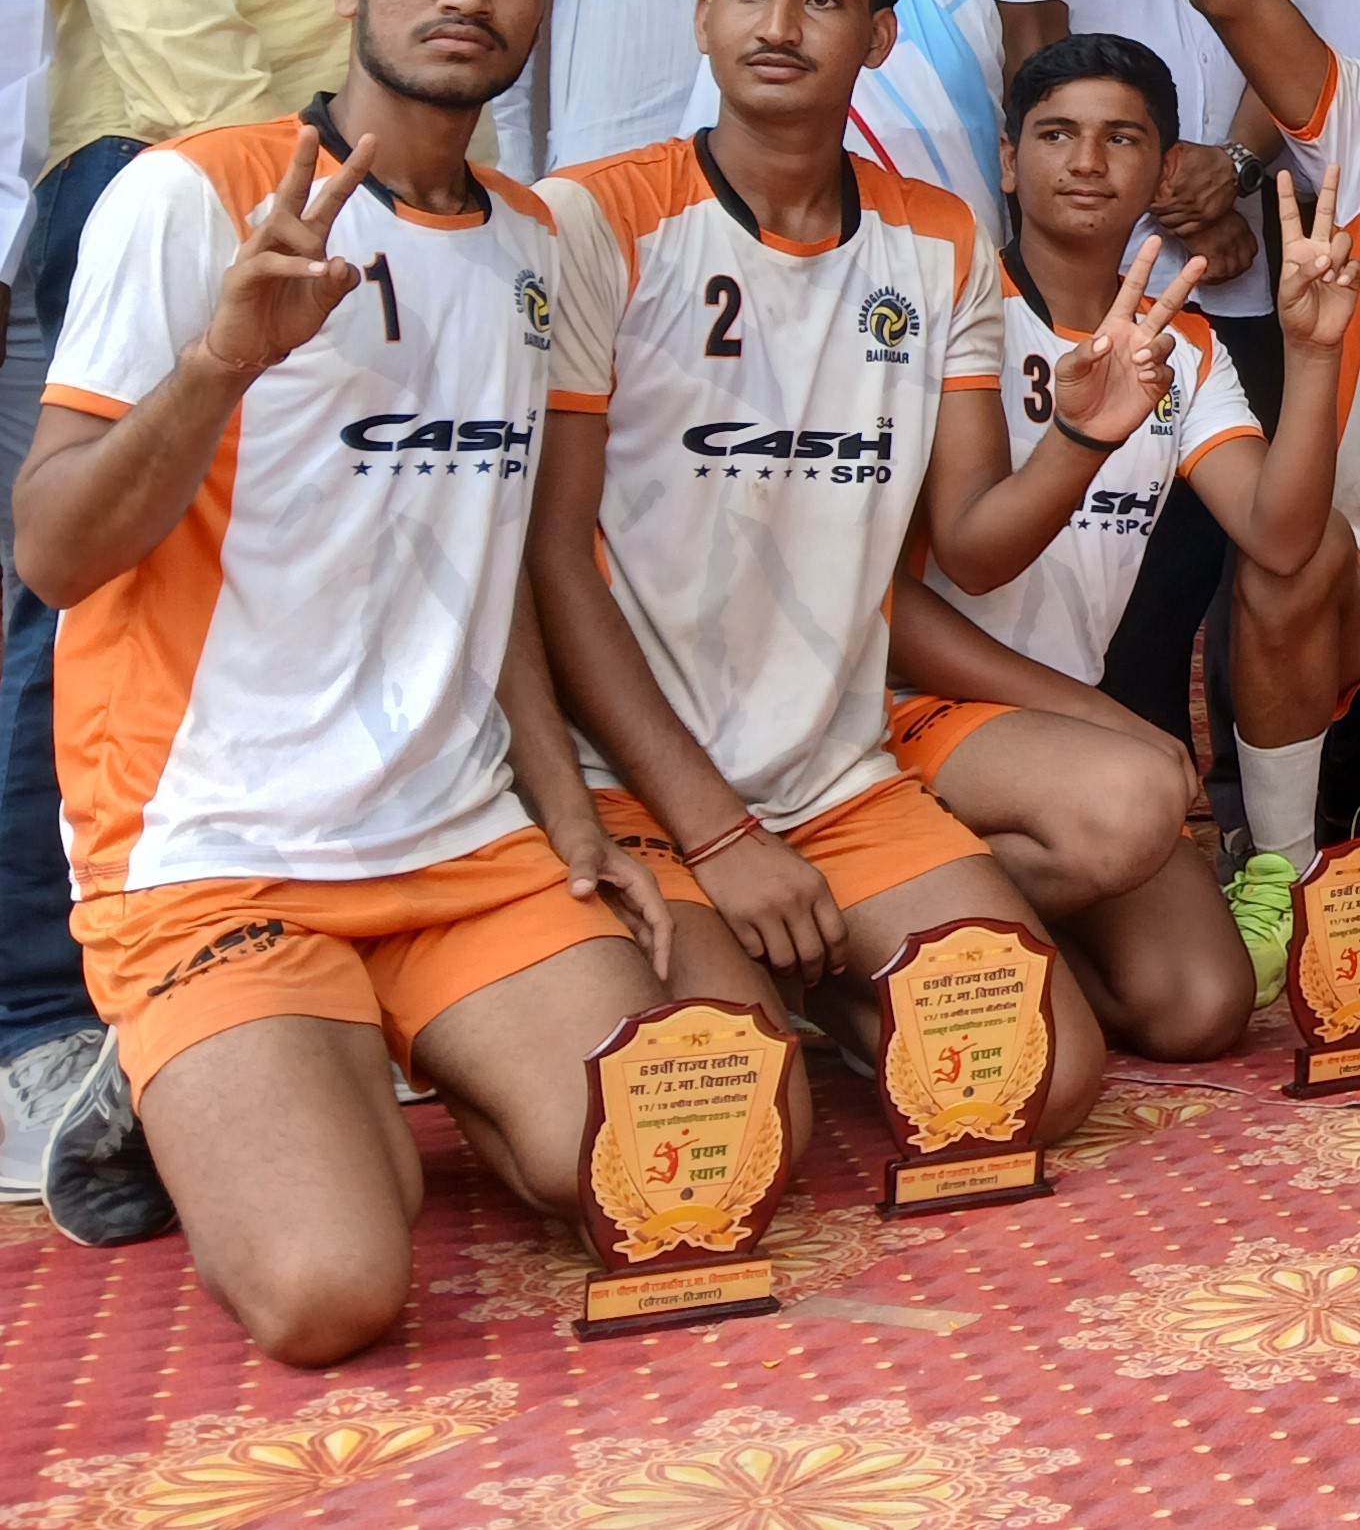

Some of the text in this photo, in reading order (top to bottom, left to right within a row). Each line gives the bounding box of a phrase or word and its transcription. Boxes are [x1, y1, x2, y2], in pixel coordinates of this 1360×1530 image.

[362, 252, 401, 344] 1
[704, 274, 743, 359] 2
[1023, 354, 1054, 424] 3
[340, 413, 534, 456] CASH
[876, 416, 895, 429] 34
[682, 422, 892, 460] CASH
[830, 465, 892, 484] SPO
[1090, 490, 1160, 516] SH
[677, 1059, 708, 1072] राज्य
[691, 1144, 728, 1161] प्रथम
[689, 1166, 727, 1182] स्थान
